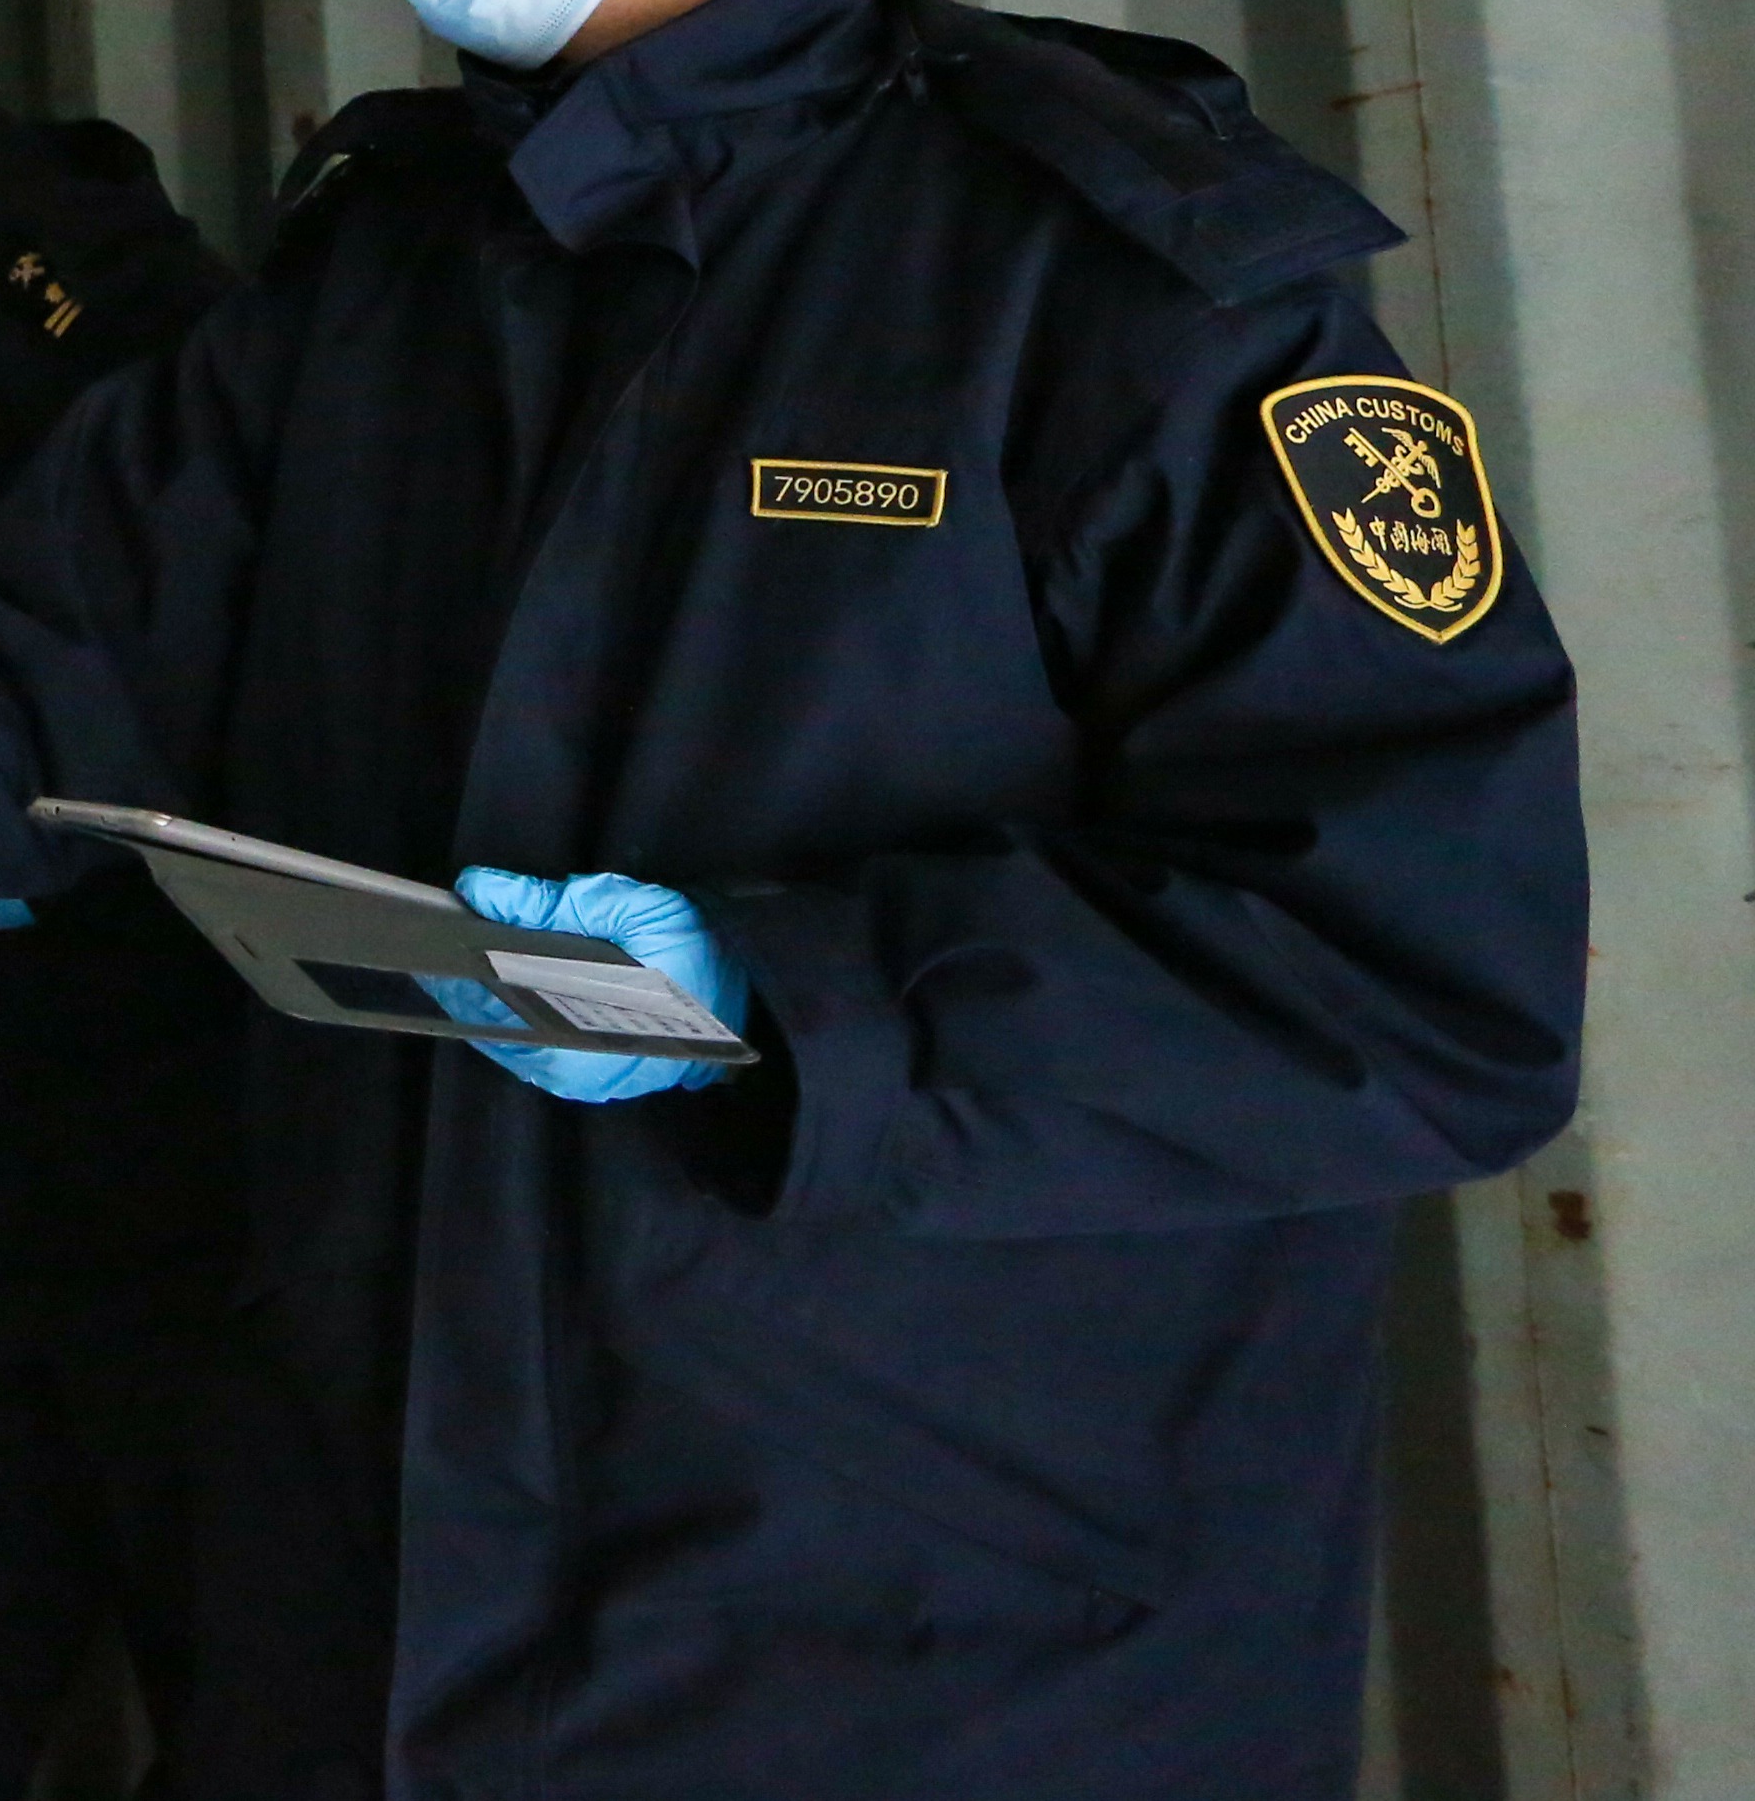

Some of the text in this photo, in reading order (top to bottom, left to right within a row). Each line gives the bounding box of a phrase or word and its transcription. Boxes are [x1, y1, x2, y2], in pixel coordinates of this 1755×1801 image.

[1284, 397, 1464, 456] CHINA CUSTOMS
[774, 476, 919, 510] 7905890
